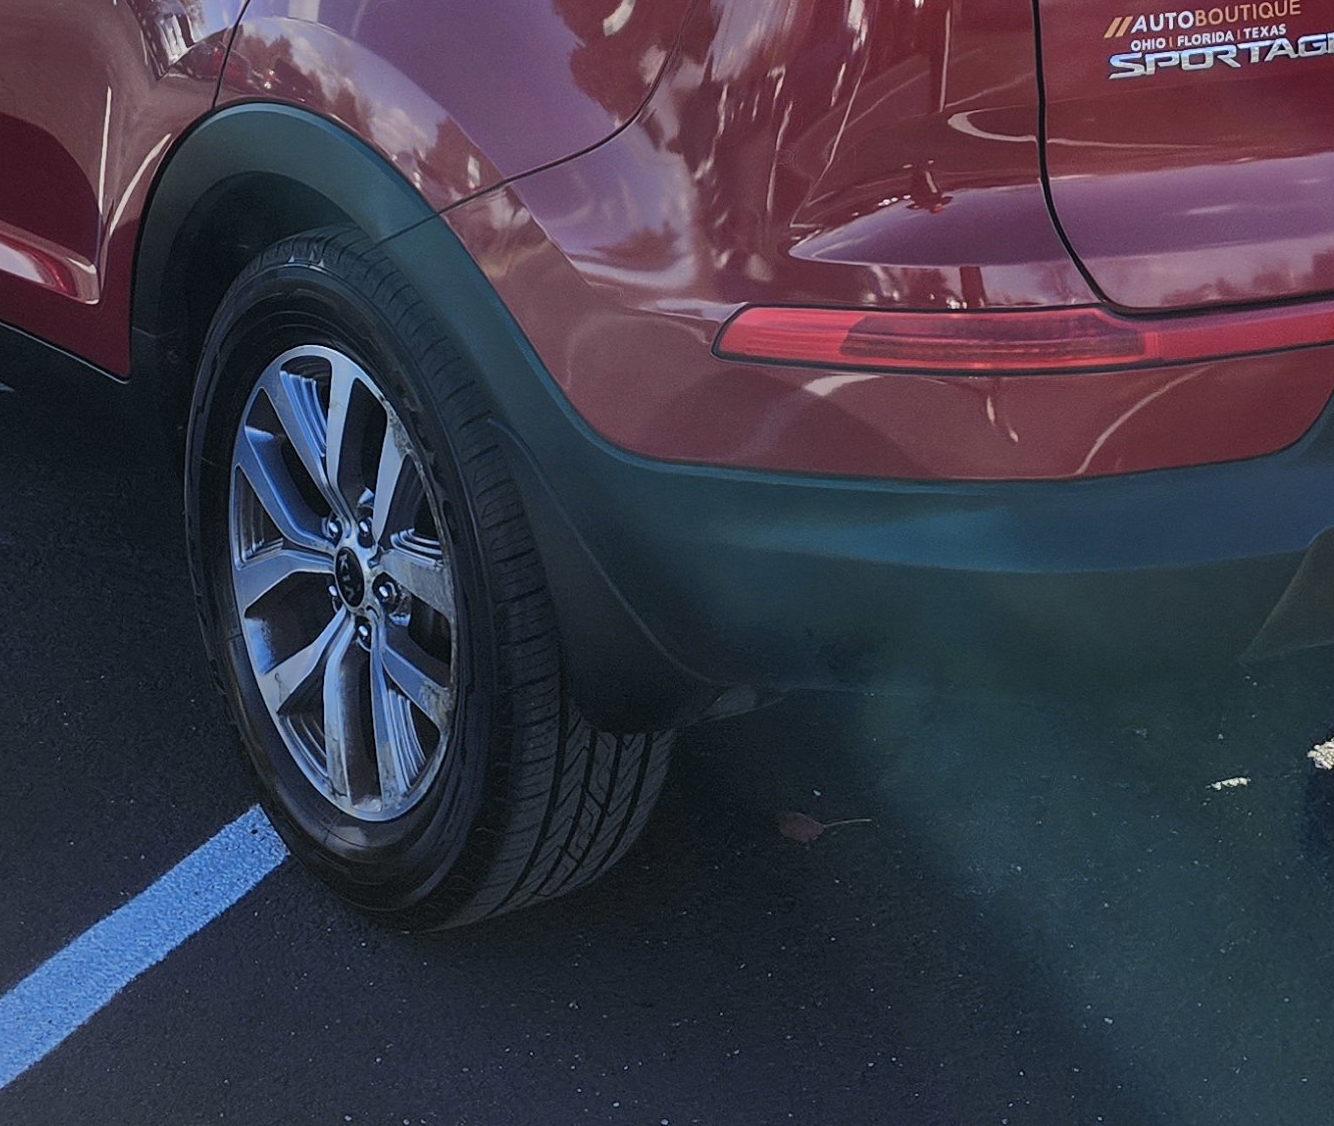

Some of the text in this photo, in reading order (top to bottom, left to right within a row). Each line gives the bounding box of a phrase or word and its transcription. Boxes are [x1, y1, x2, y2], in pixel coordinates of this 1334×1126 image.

[1130, 23, 1287, 52] OHIO FLORIDA TEXAS
